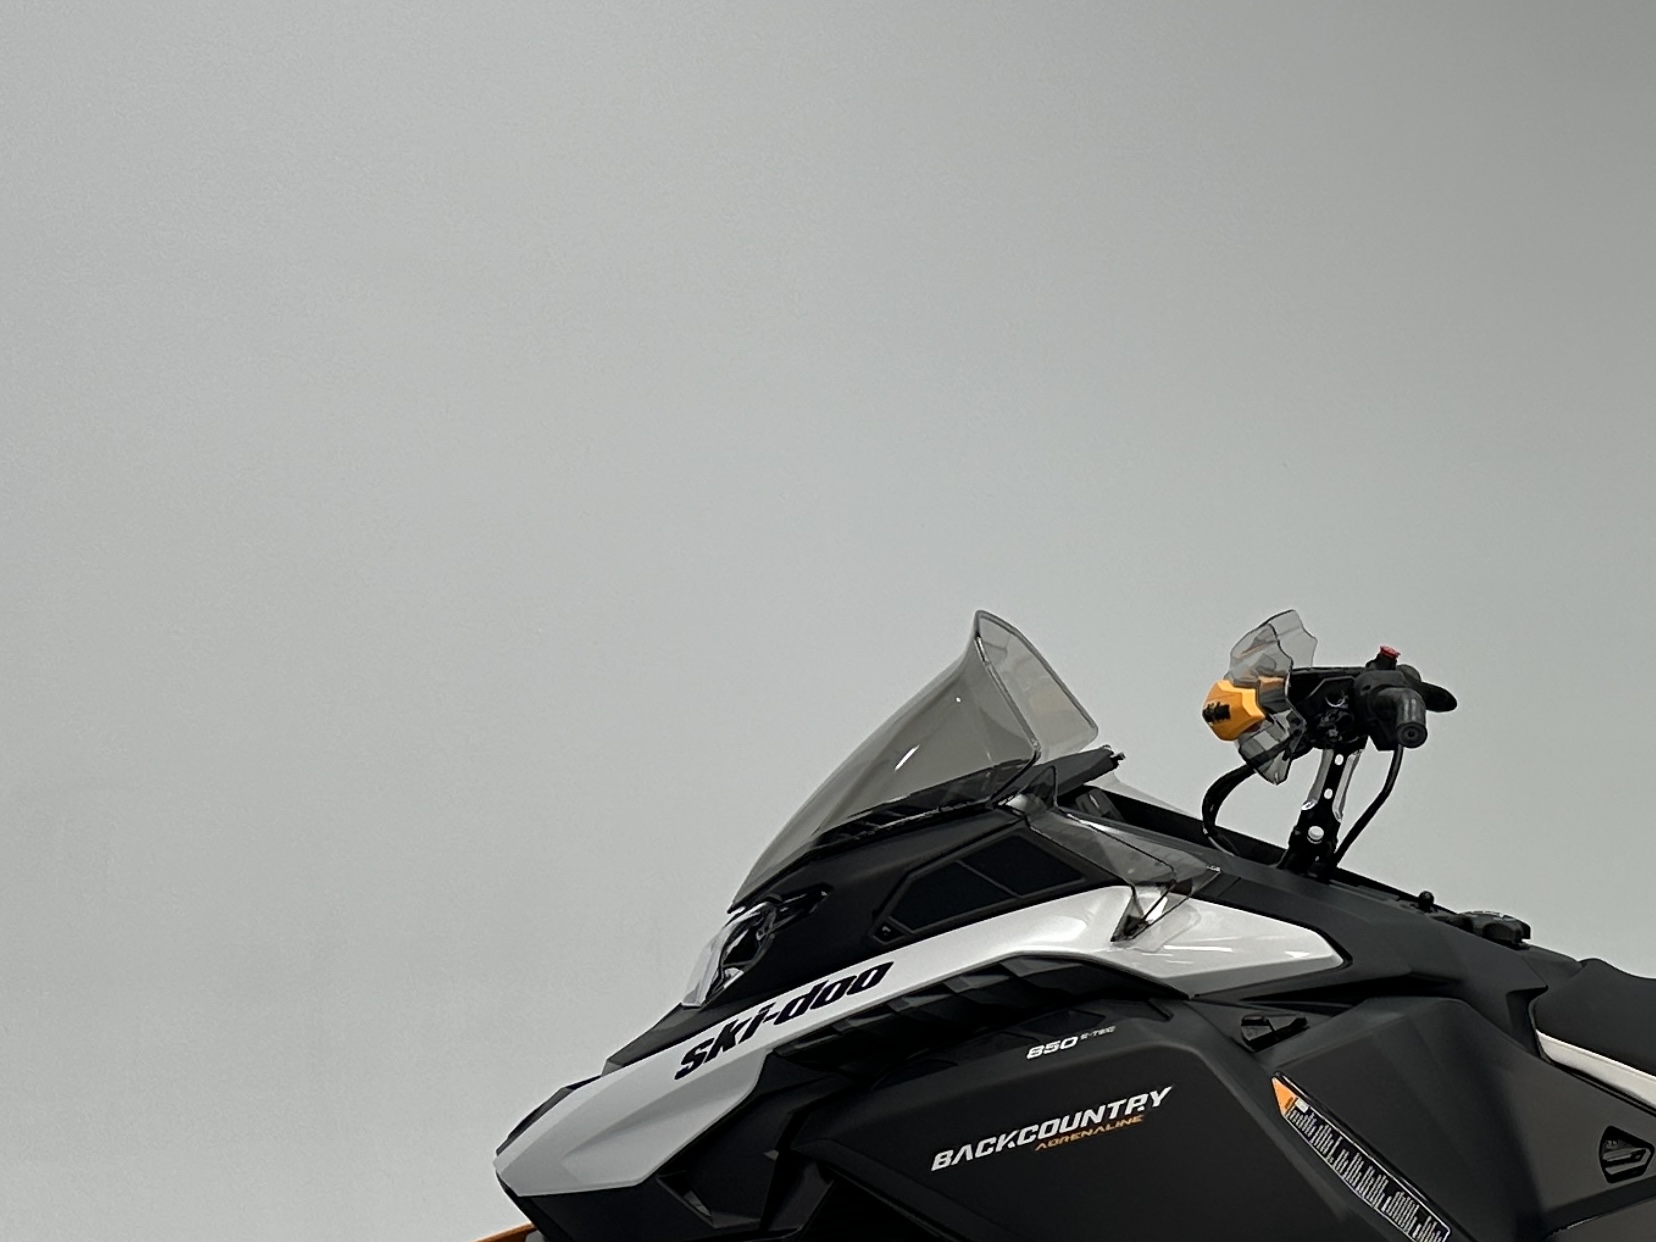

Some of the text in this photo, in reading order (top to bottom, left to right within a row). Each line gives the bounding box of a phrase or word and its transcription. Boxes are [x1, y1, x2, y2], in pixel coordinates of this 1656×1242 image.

[674, 961, 895, 1081] ski-doo
[1025, 1036, 1078, 1060] 850
[931, 1085, 1174, 1171] BACKCOUNTRY
[1034, 1114, 1145, 1151] ADRENALINE
